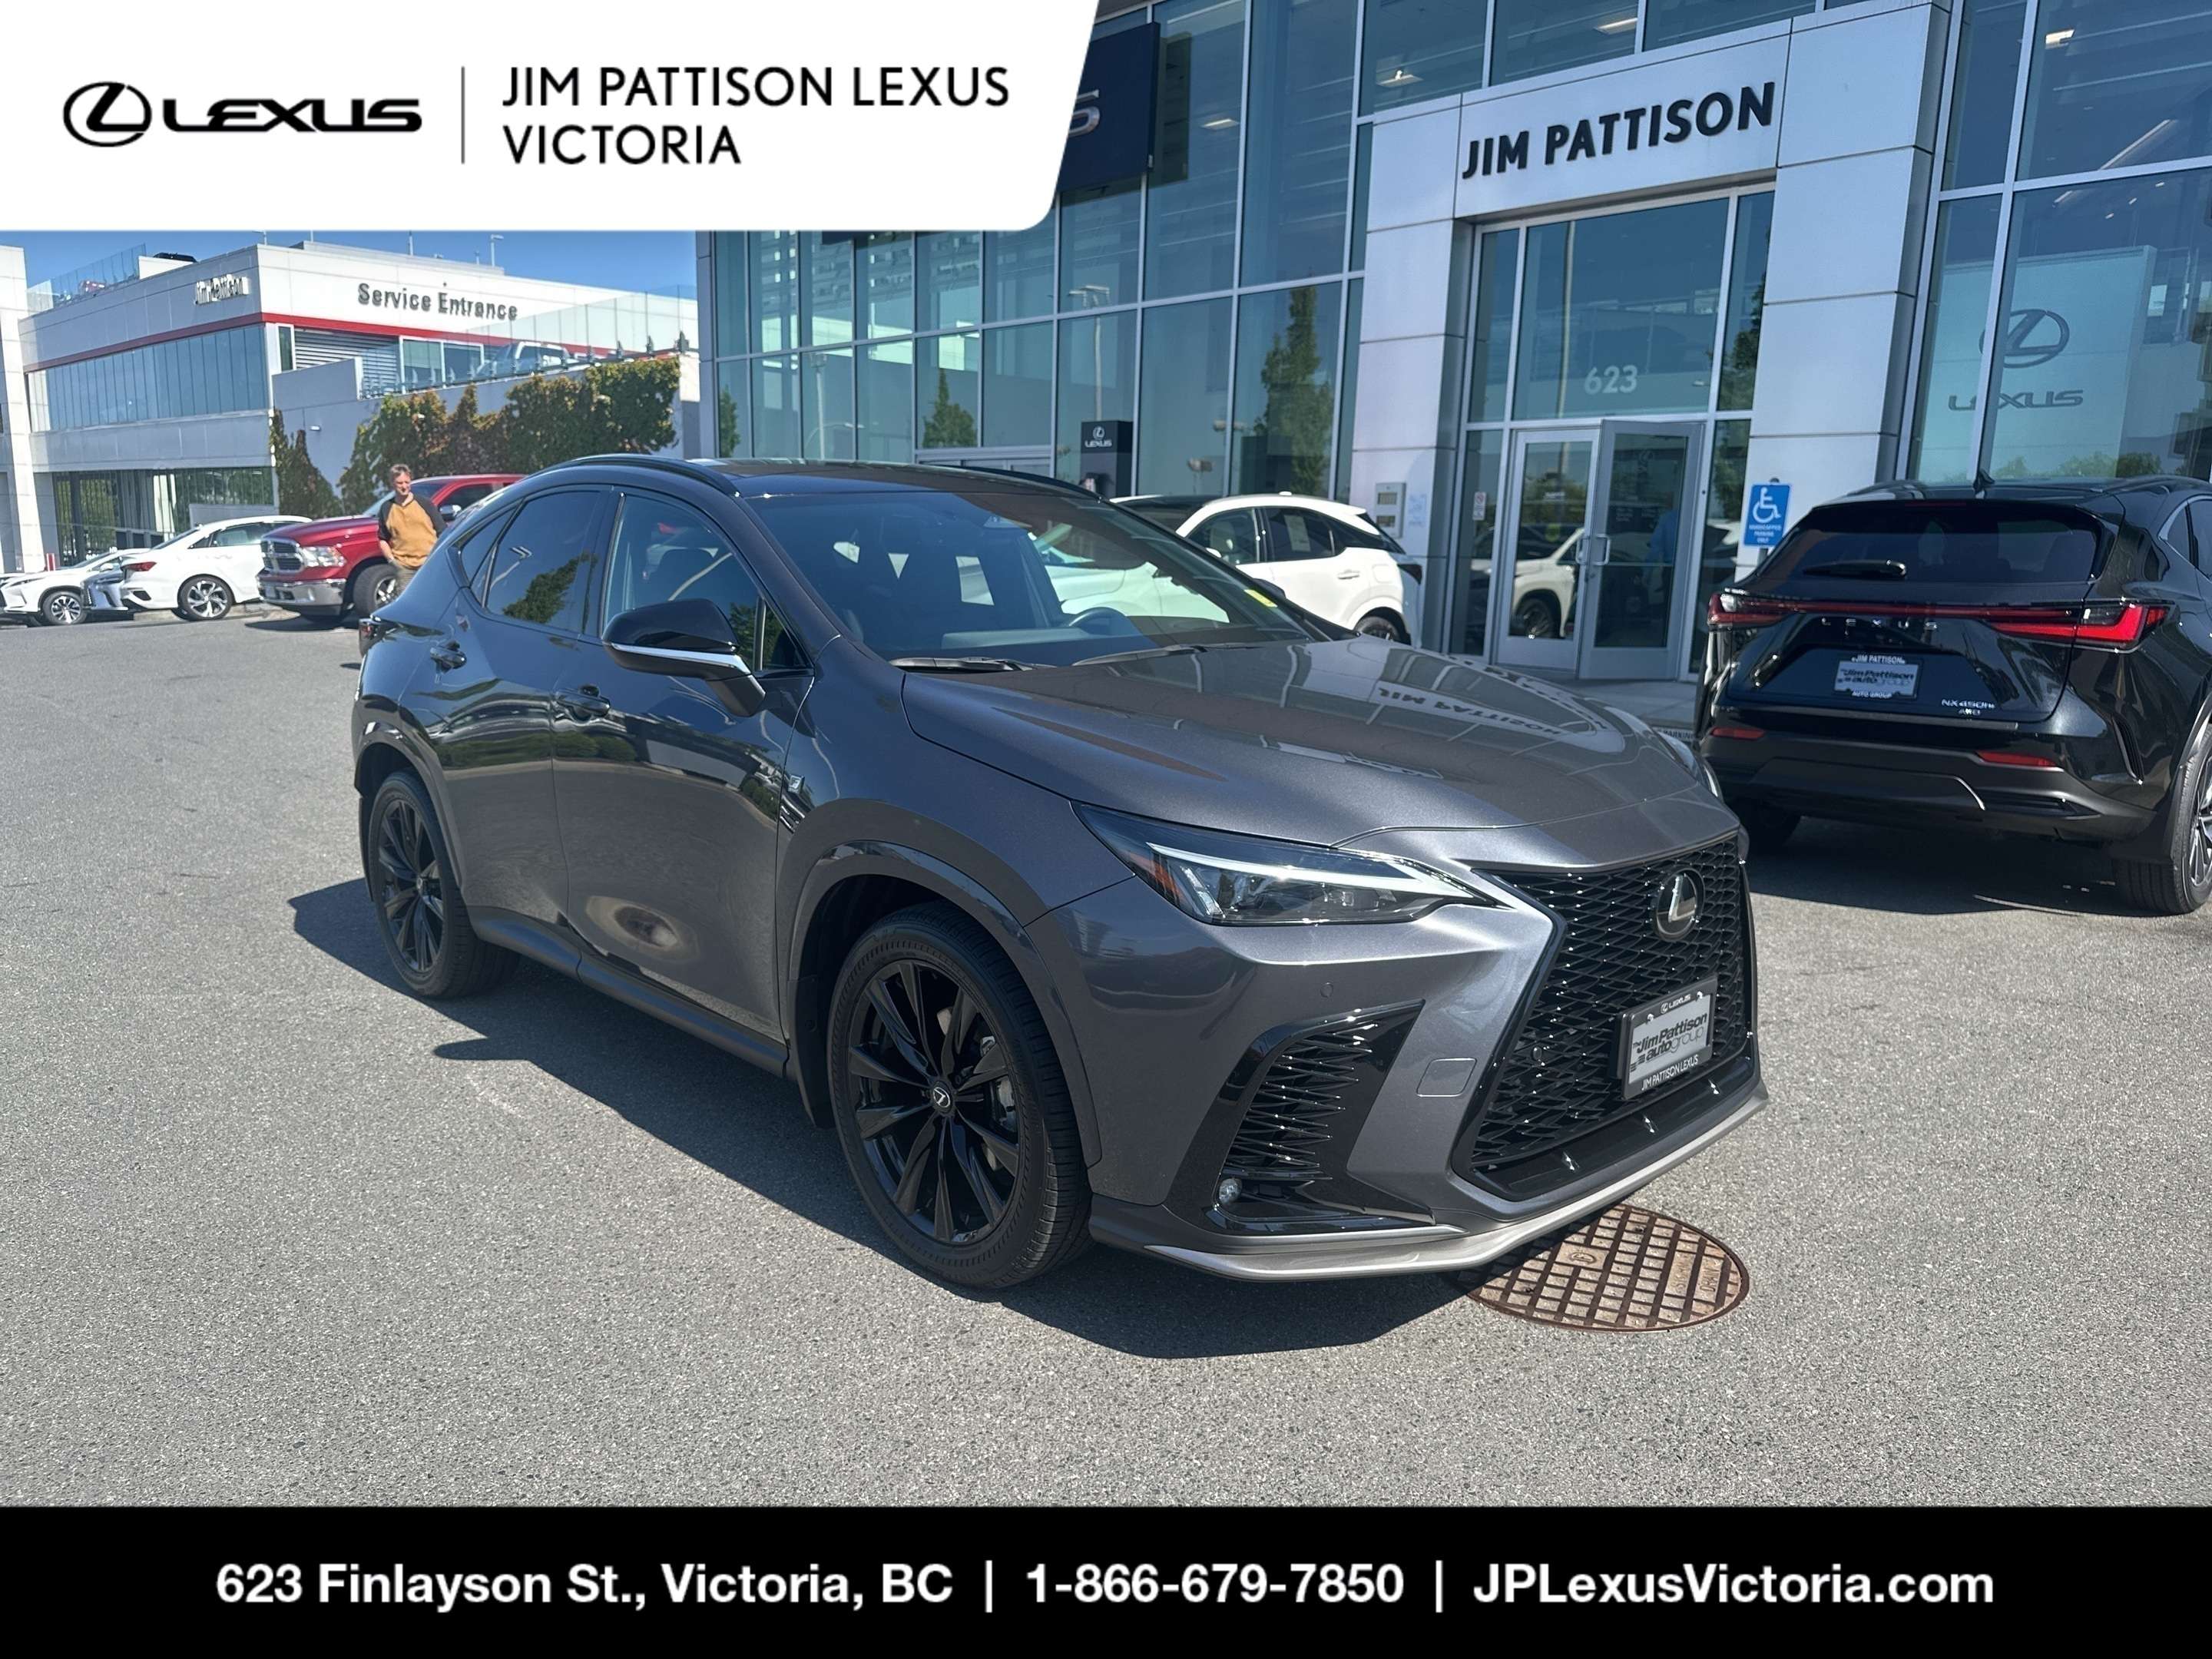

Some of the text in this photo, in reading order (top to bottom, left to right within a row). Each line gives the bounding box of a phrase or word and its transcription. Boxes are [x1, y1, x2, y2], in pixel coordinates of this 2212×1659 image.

[1462, 81, 1775, 180] JIM PATTISON
[358, 282, 518, 321] Service Entrance
[1584, 365, 1637, 395] 623
[1856, 654, 1902, 664] JIM PATTISON
[1668, 994, 1691, 1008] LEXUS
[1637, 1035, 1659, 1053] Jim
[1659, 1012, 1707, 1045] Pattison
[1642, 1054, 1699, 1091] JIM PATTISON LEXUS
